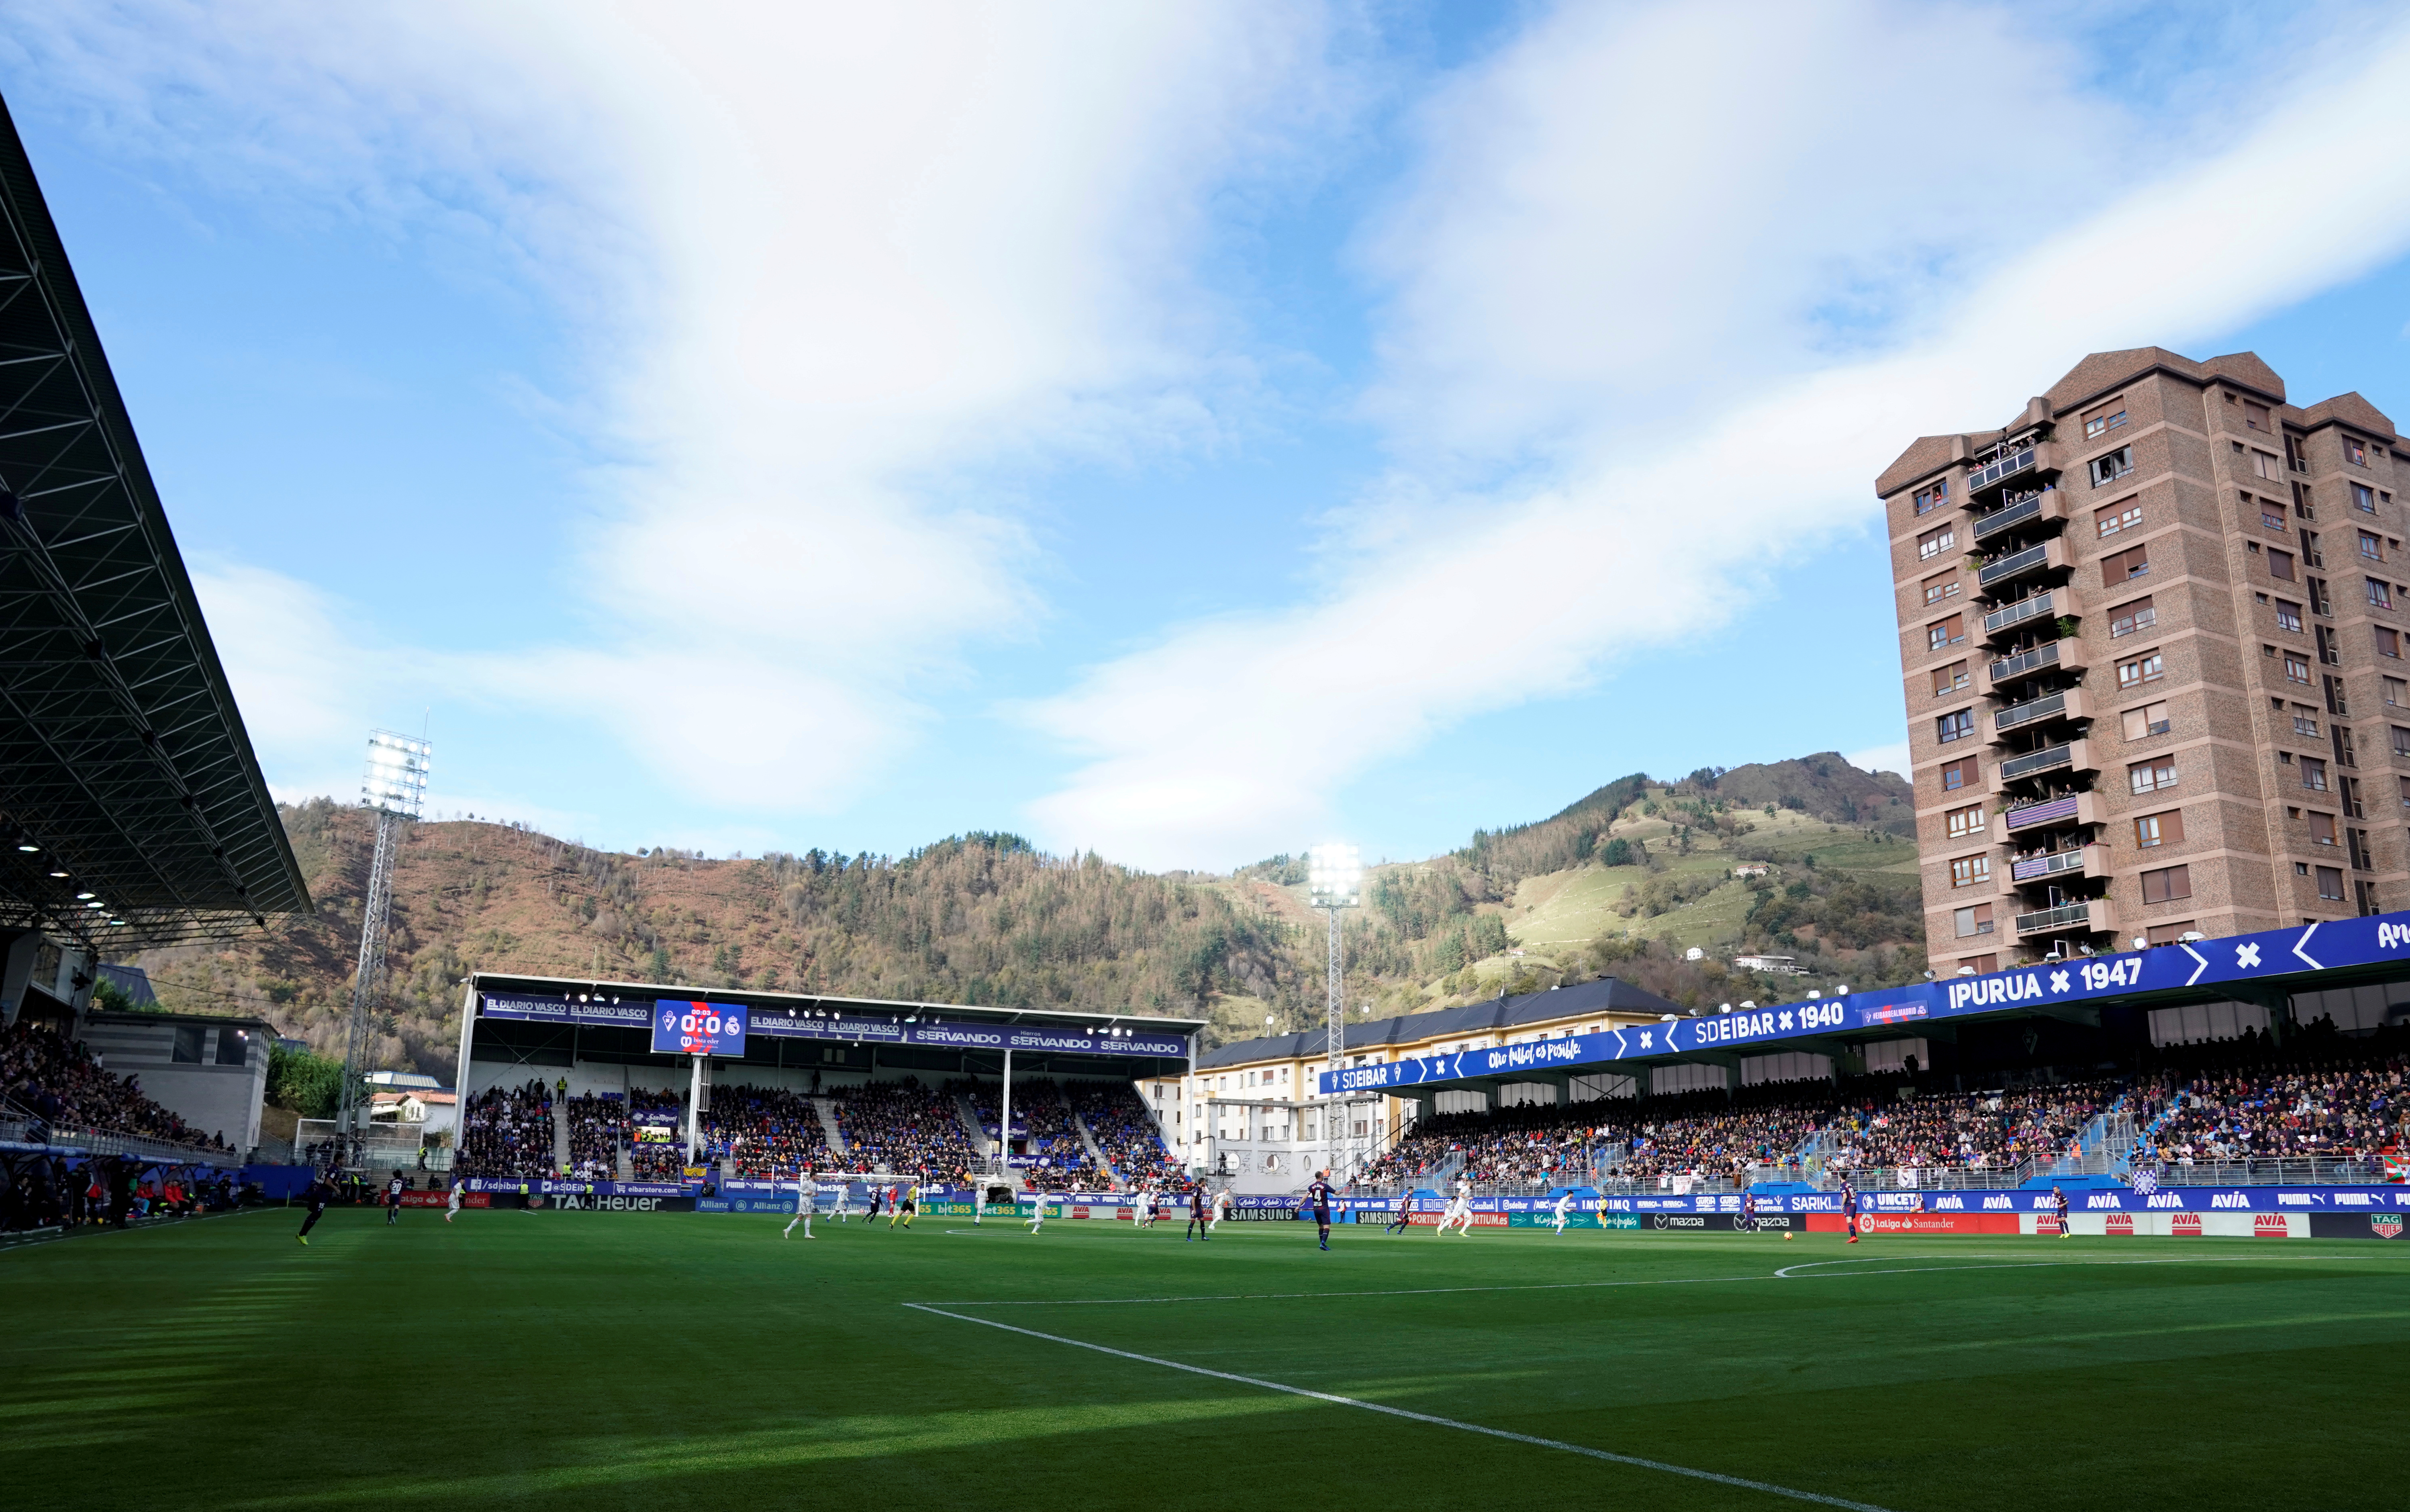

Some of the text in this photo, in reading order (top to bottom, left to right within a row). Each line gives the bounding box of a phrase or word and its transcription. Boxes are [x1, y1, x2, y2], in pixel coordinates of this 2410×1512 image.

[2378, 922, 2410, 949] An
[1948, 957, 2142, 1009] IPURUA 1947
[487, 999, 566, 1012] EL DIARIO VASCO
[570, 1005, 647, 1018] EL DIARIO VASCO
[1798, 1001, 1844, 1029] 1940
[1873, 1007, 1916, 1020] #EIBARREALMADRID
[681, 1015, 721, 1034] 0:0
[751, 1017, 824, 1029] EL DIARIO VASCO
[839, 1023, 869, 1032] DIARIO
[870, 1024, 899, 1033] VASCO
[916, 1030, 1001, 1044] SERVANDO
[1010, 1036, 1091, 1049] SERVANDO
[1101, 1040, 1178, 1053] SERVANDO
[392, 1183, 402, 1191] 20
[1314, 1189, 1321, 1201] 4
[2278, 1193, 2311, 1205] PUMA
[2334, 1193, 2370, 1205] PUMA
[700, 1200, 780, 1210] Allianz Allianz
[1470, 1201, 1494, 1210] CaixaBank
[1609, 1199, 1630, 1212] IMQ
[1792, 1196, 1831, 1210] SARIKI
[1230, 1209, 1292, 1220] SAMSUNG
[2373, 1216, 2399, 1224] TAG
[1877, 1218, 1955, 1230] LaLiga Santander
[2373, 1224, 2401, 1236] HEUER
